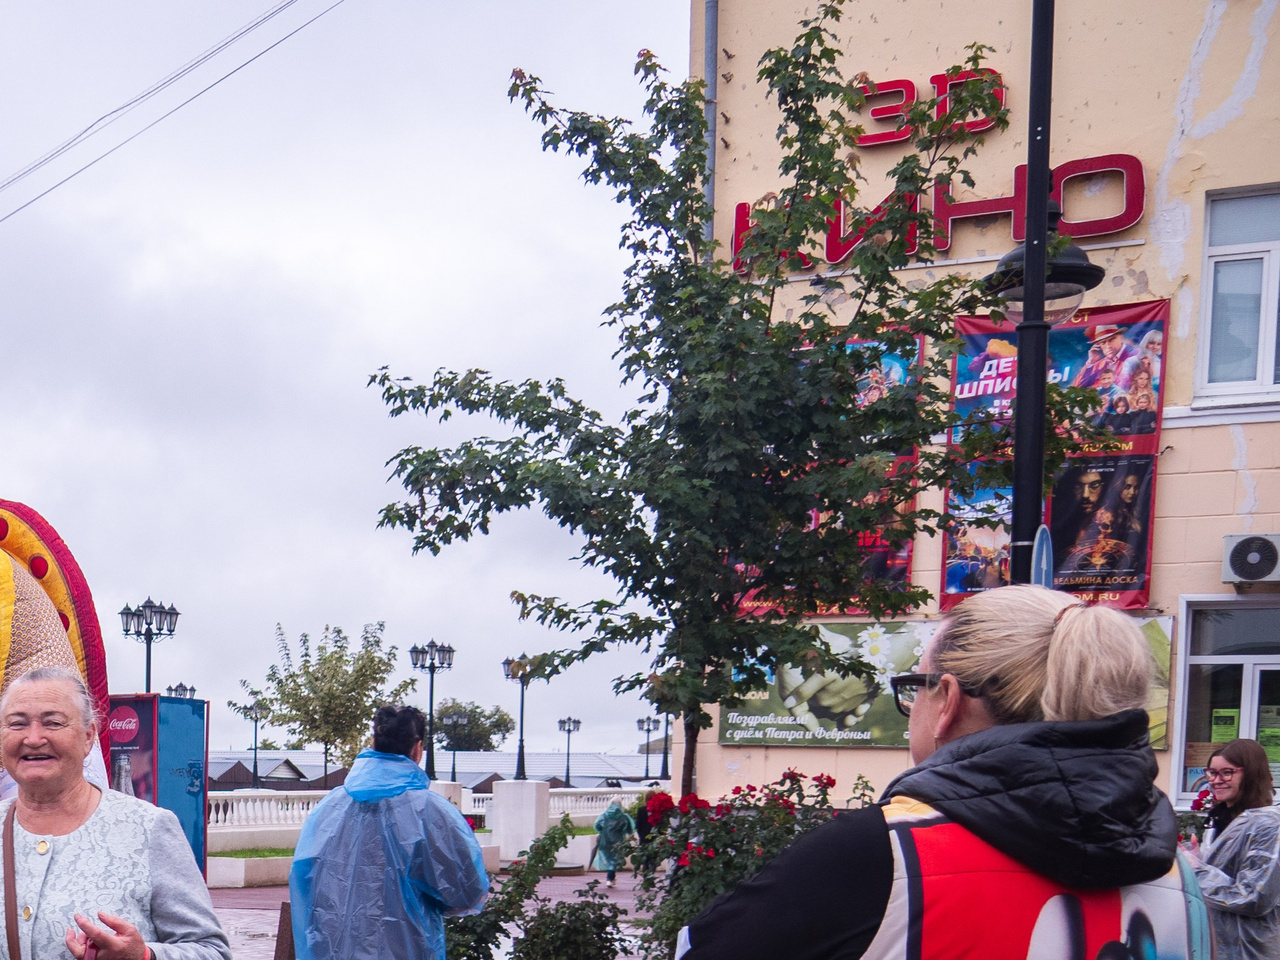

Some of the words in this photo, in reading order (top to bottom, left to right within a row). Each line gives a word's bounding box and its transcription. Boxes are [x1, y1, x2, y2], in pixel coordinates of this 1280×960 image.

[853, 67, 1006, 148] 3D
[1053, 576, 1102, 585] ВЕДЬМИНА
[1104, 575, 1139, 585] ДОСКА
[727, 712, 810, 727] Поздравляем!
[733, 727, 764, 741] днём
[765, 727, 804, 742] Петра
[805, 731, 813, 739] и
[815, 727, 871, 742] Февроньи
